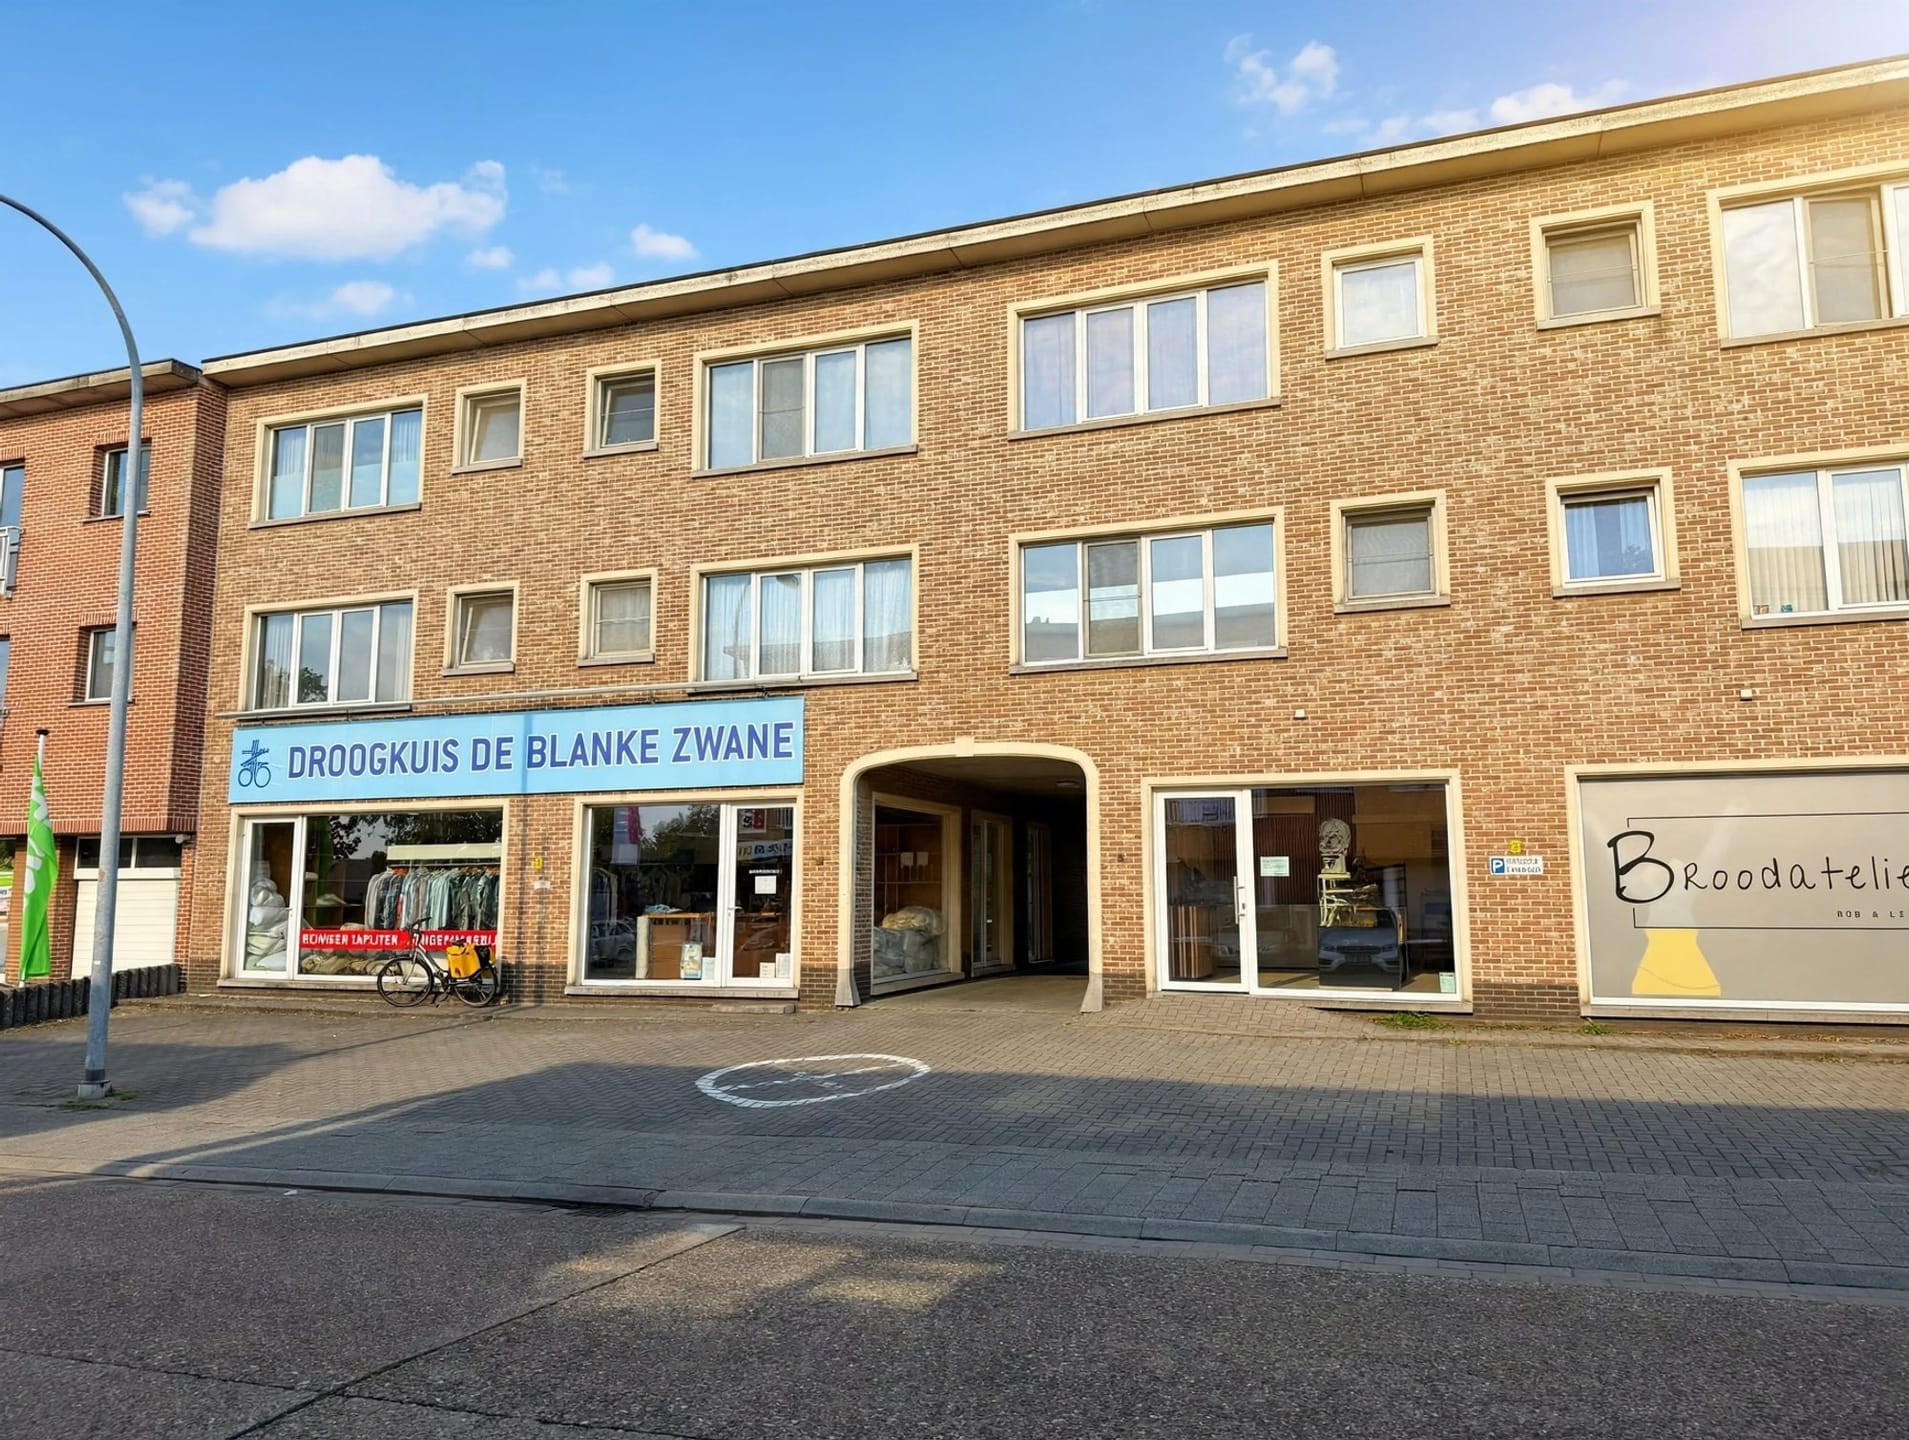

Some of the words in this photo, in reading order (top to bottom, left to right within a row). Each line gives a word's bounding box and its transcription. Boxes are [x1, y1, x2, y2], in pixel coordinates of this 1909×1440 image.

[287, 737, 460, 779] DROOGKUIS
[471, 736, 515, 772] DE
[526, 728, 659, 769] BLANKE
[671, 721, 794, 763] ZWANE
